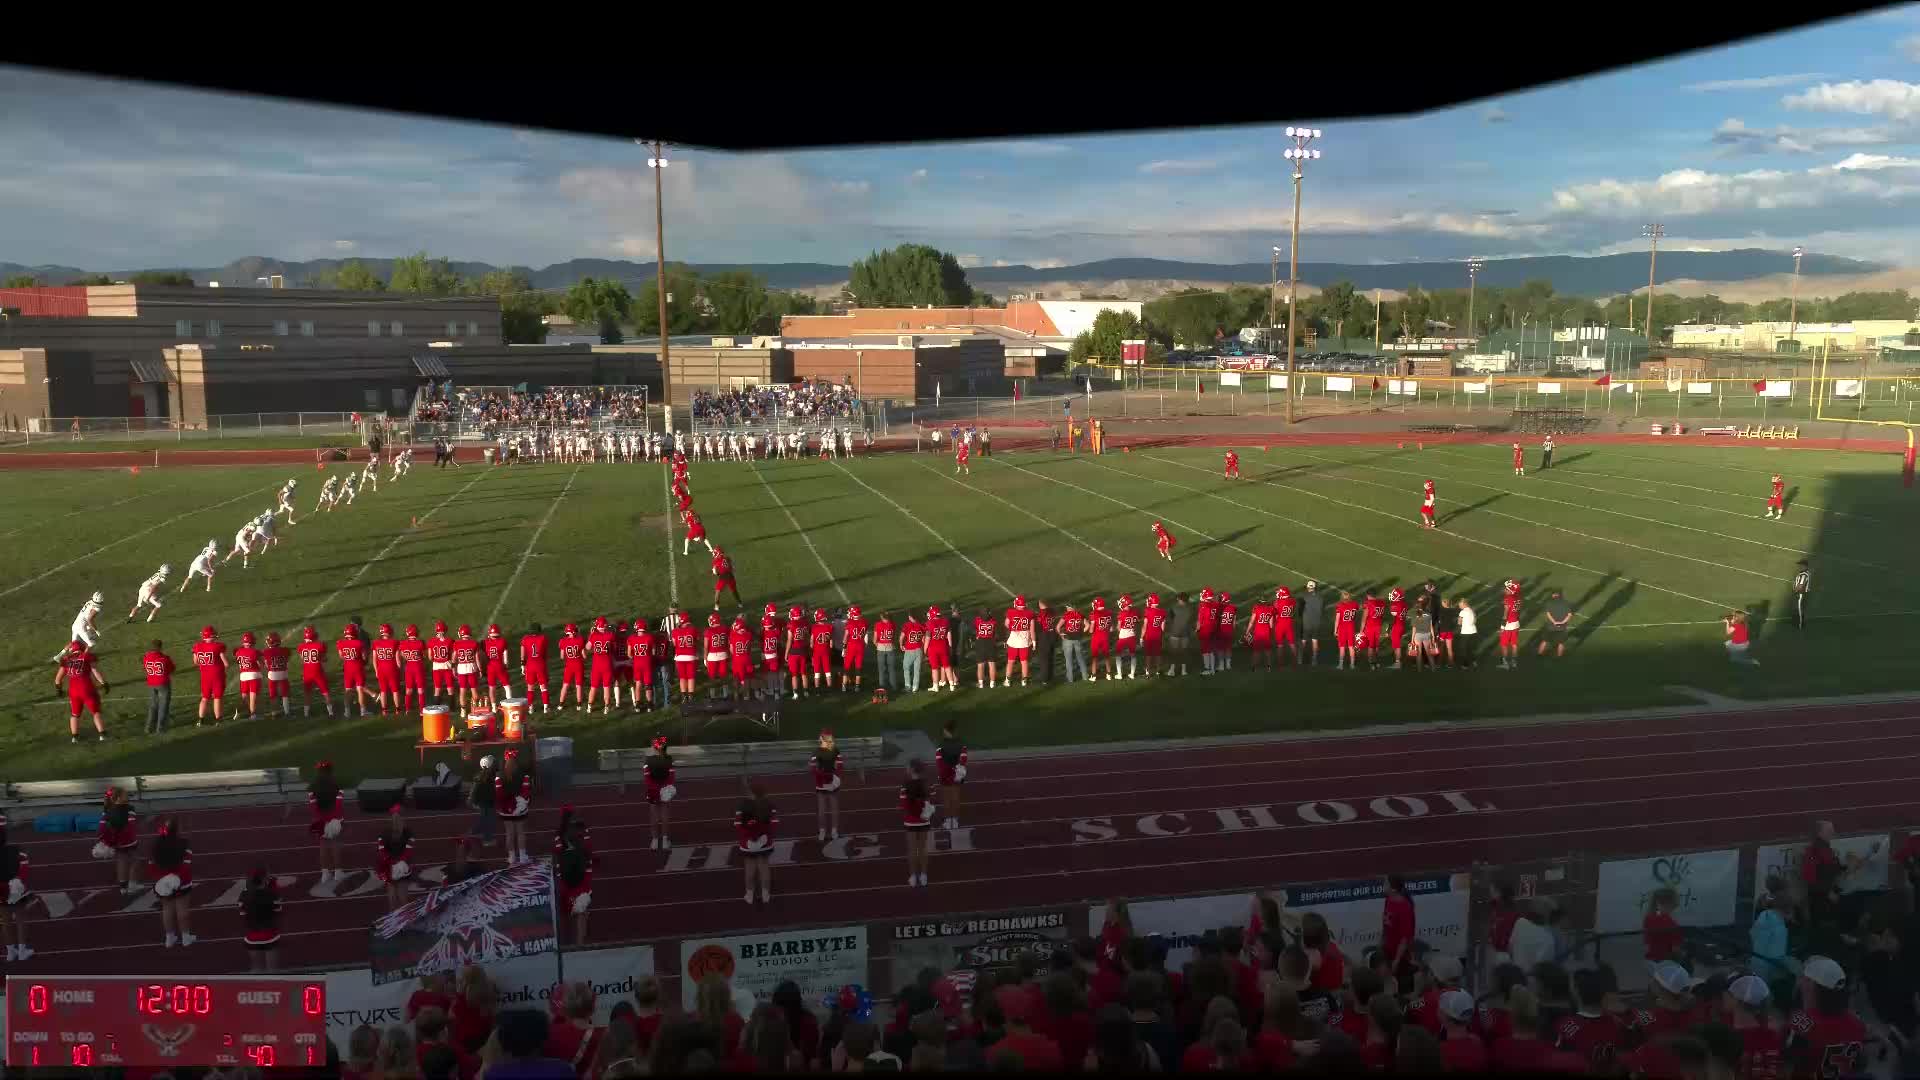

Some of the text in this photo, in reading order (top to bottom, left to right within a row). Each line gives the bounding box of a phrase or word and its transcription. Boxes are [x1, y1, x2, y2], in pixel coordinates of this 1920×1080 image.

[433, 645, 448, 659] 10
[532, 643, 539, 657] 1
[633, 643, 647, 656] 17
[197, 651, 214, 665] 67
[145, 661, 165, 676] 53
[509, 710, 521, 723] G
[1071, 789, 1500, 847] SCHOOL
[895, 923, 937, 938] LET'S
[968, 913, 1064, 933] REDHAWKS!
[740, 936, 857, 959] BEARBYTE
[757, 956, 809, 968] STUDIOS
